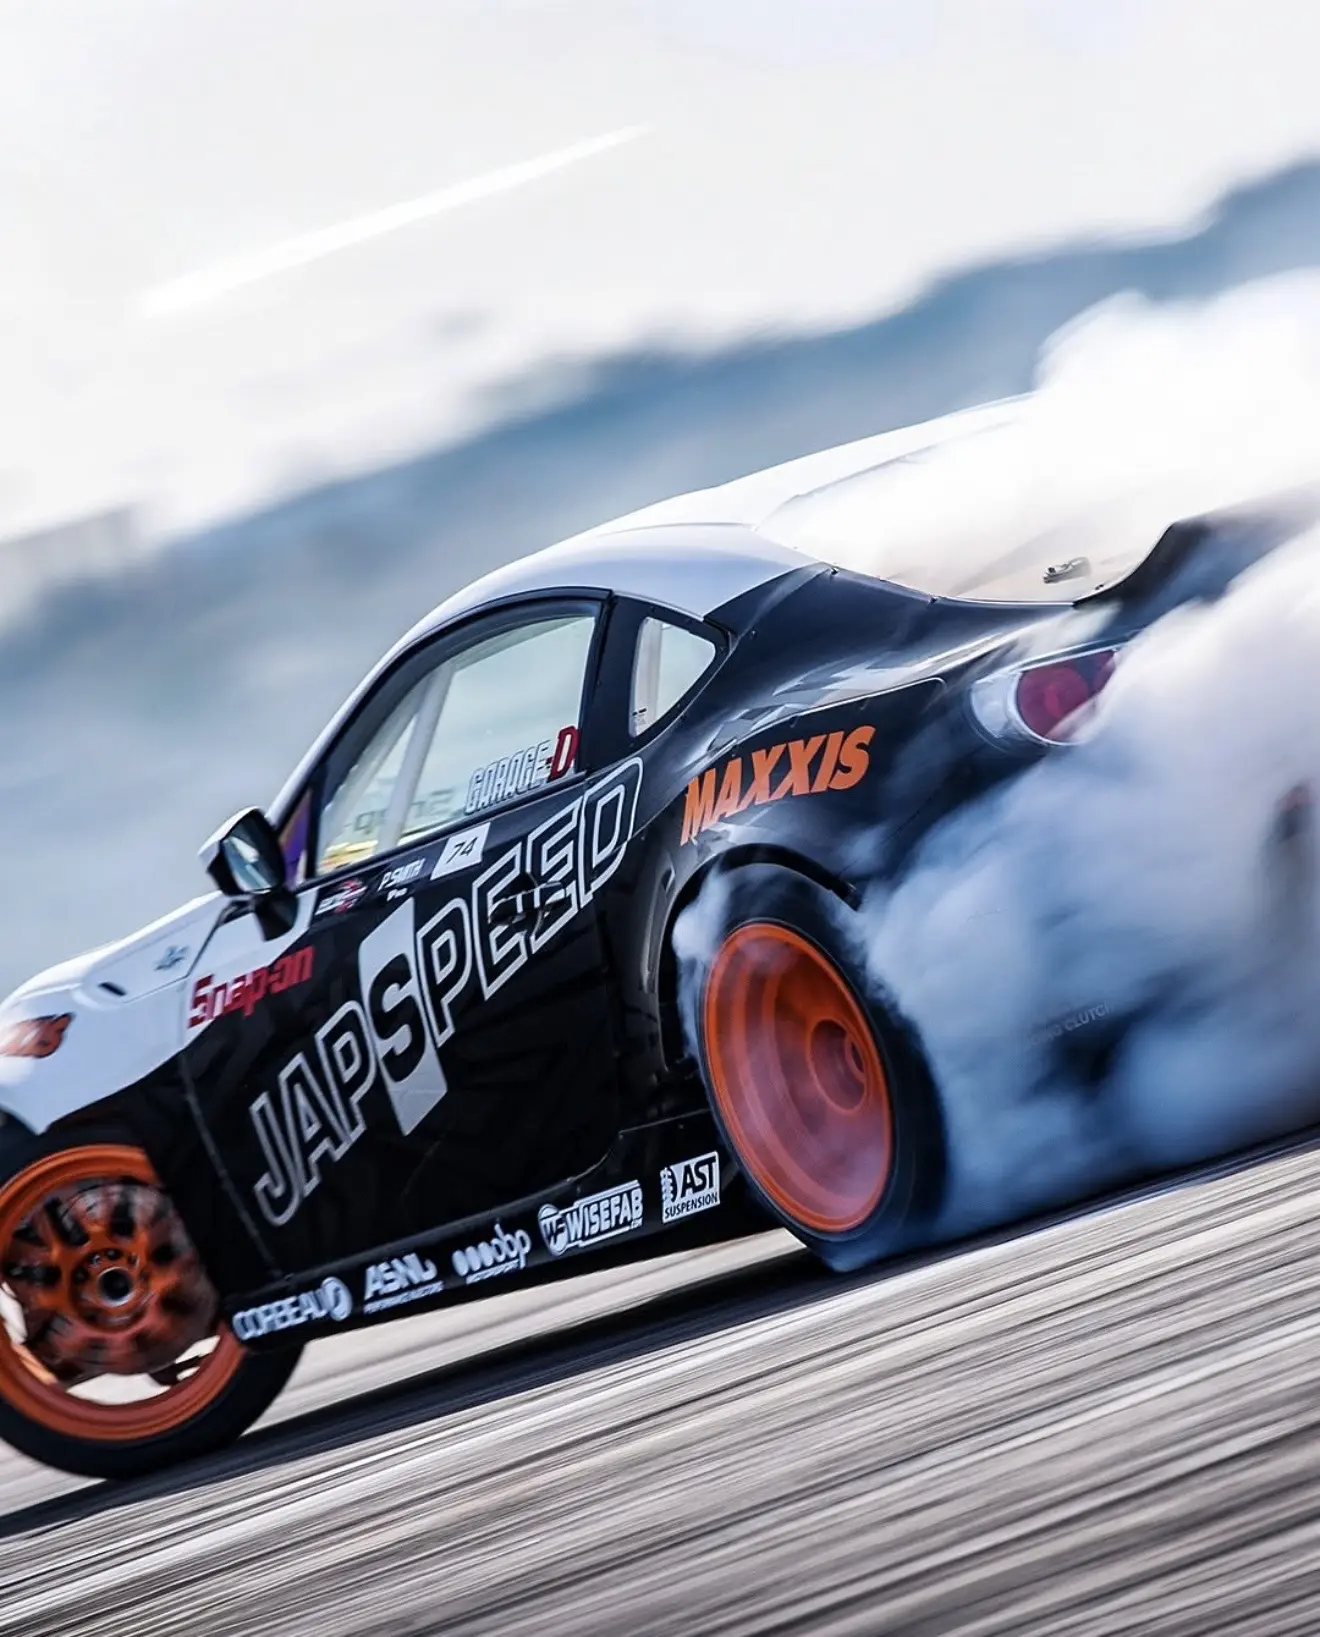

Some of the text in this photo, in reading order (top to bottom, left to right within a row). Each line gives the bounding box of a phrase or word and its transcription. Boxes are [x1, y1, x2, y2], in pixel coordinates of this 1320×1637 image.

[680, 725, 876, 846] MAXXIS
[446, 837, 478, 864] 74
[187, 945, 315, 1029] Snap-on
[249, 757, 643, 1226] JAPSPEED
[681, 1156, 717, 1198] AST
[566, 1187, 643, 1241] WISEFAB
[664, 1192, 718, 1219] SUSPENSION
